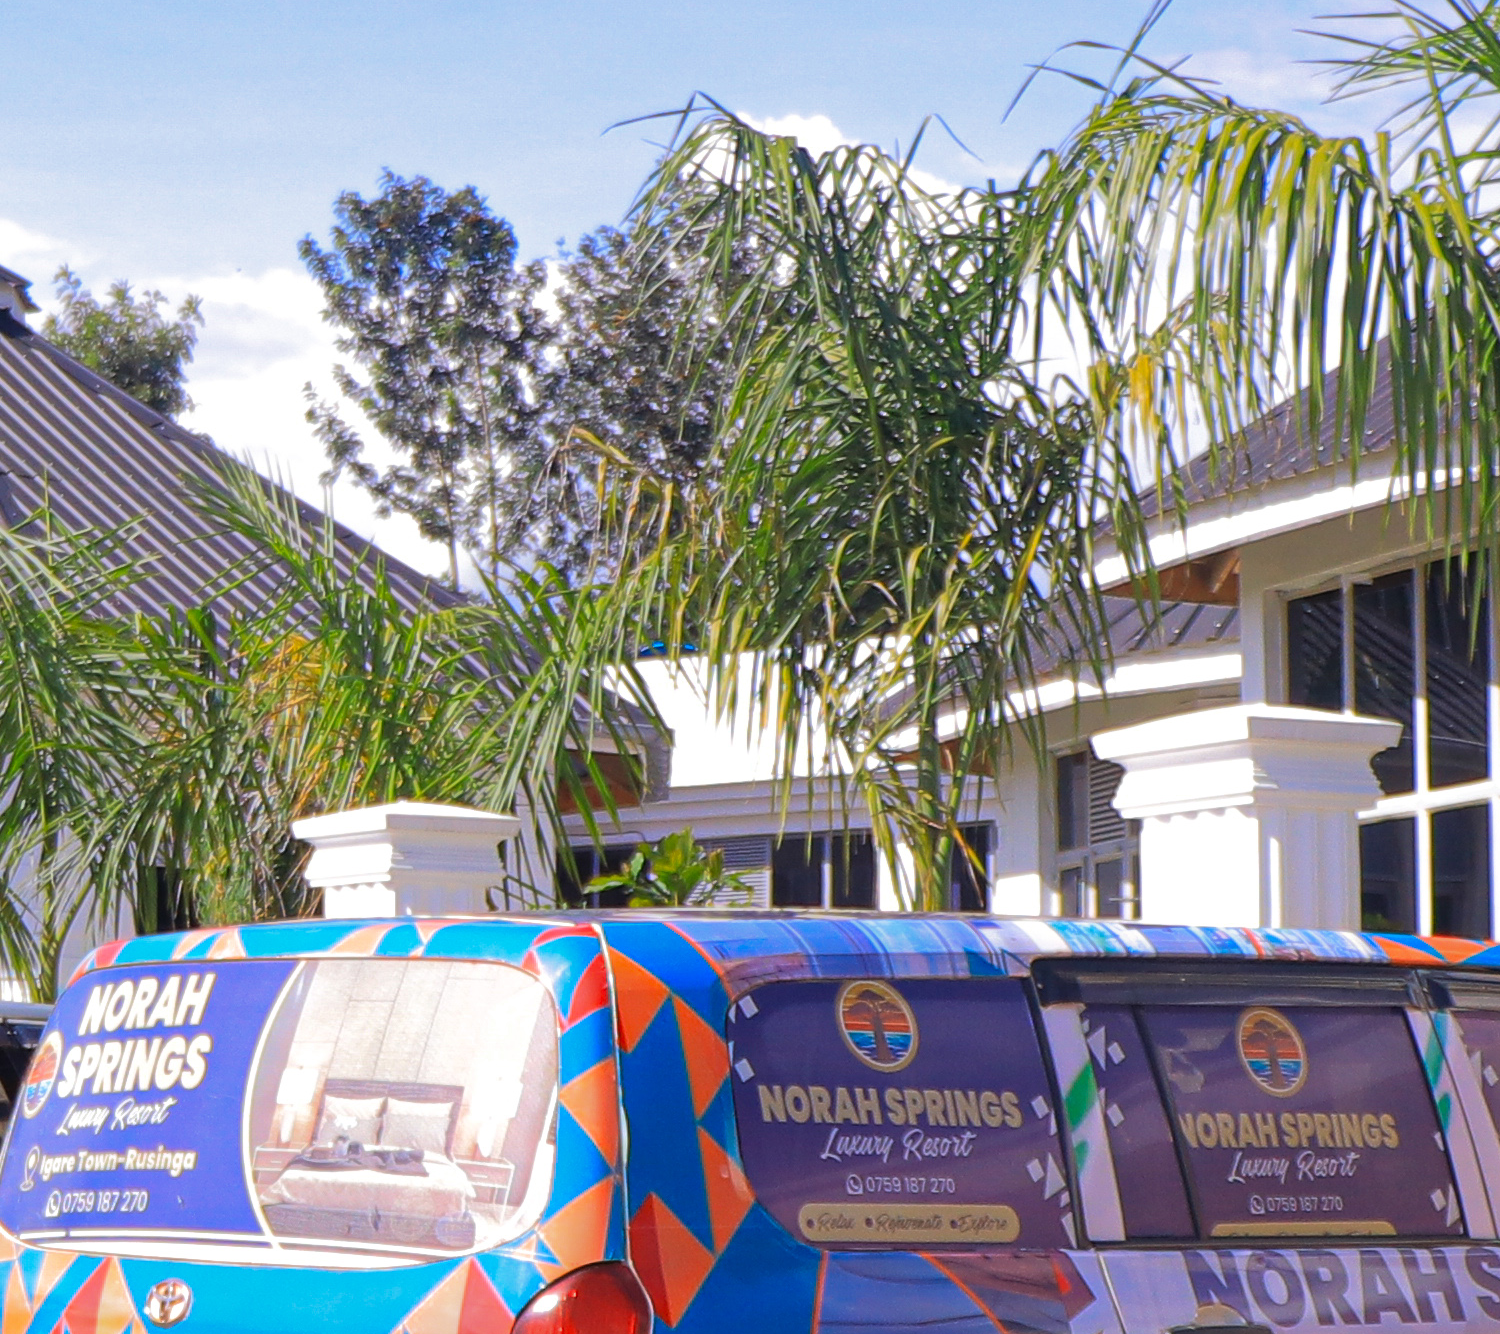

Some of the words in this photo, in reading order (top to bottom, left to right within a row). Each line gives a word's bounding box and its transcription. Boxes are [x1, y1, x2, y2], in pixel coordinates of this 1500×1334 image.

[78, 971, 217, 1036] NORAH
[57, 1034, 213, 1097] SPRINGS
[56, 1103, 109, 1135] Luxury
[110, 1096, 177, 1130] Resort
[757, 1084, 883, 1125] NORAH
[884, 1087, 1023, 1128] SPRINGS
[820, 1128, 894, 1163] Luxury
[903, 1128, 977, 1162] Resort
[1178, 1113, 1280, 1148] NORAH
[1280, 1112, 1399, 1148] SPRINGS
[39, 1154, 76, 1181] Igare
[77, 1143, 197, 1178] Town-Rusinga
[1227, 1150, 1290, 1184] Luxury
[1297, 1150, 1360, 1181] Resort
[63, 1191, 94, 1213] 0759
[98, 1191, 119, 1212] 187
[120, 1191, 148, 1212] 270
[866, 1176, 901, 1193] 0759
[904, 1177, 926, 1193] 187
[930, 1177, 955, 1194] 270
[817, 1212, 855, 1232] Relax
[1266, 1196, 1297, 1212] 0759
[1299, 1196, 1318, 1212] 187
[1322, 1196, 1344, 1212] 270
[1181, 1248, 1467, 1328] NORAH
